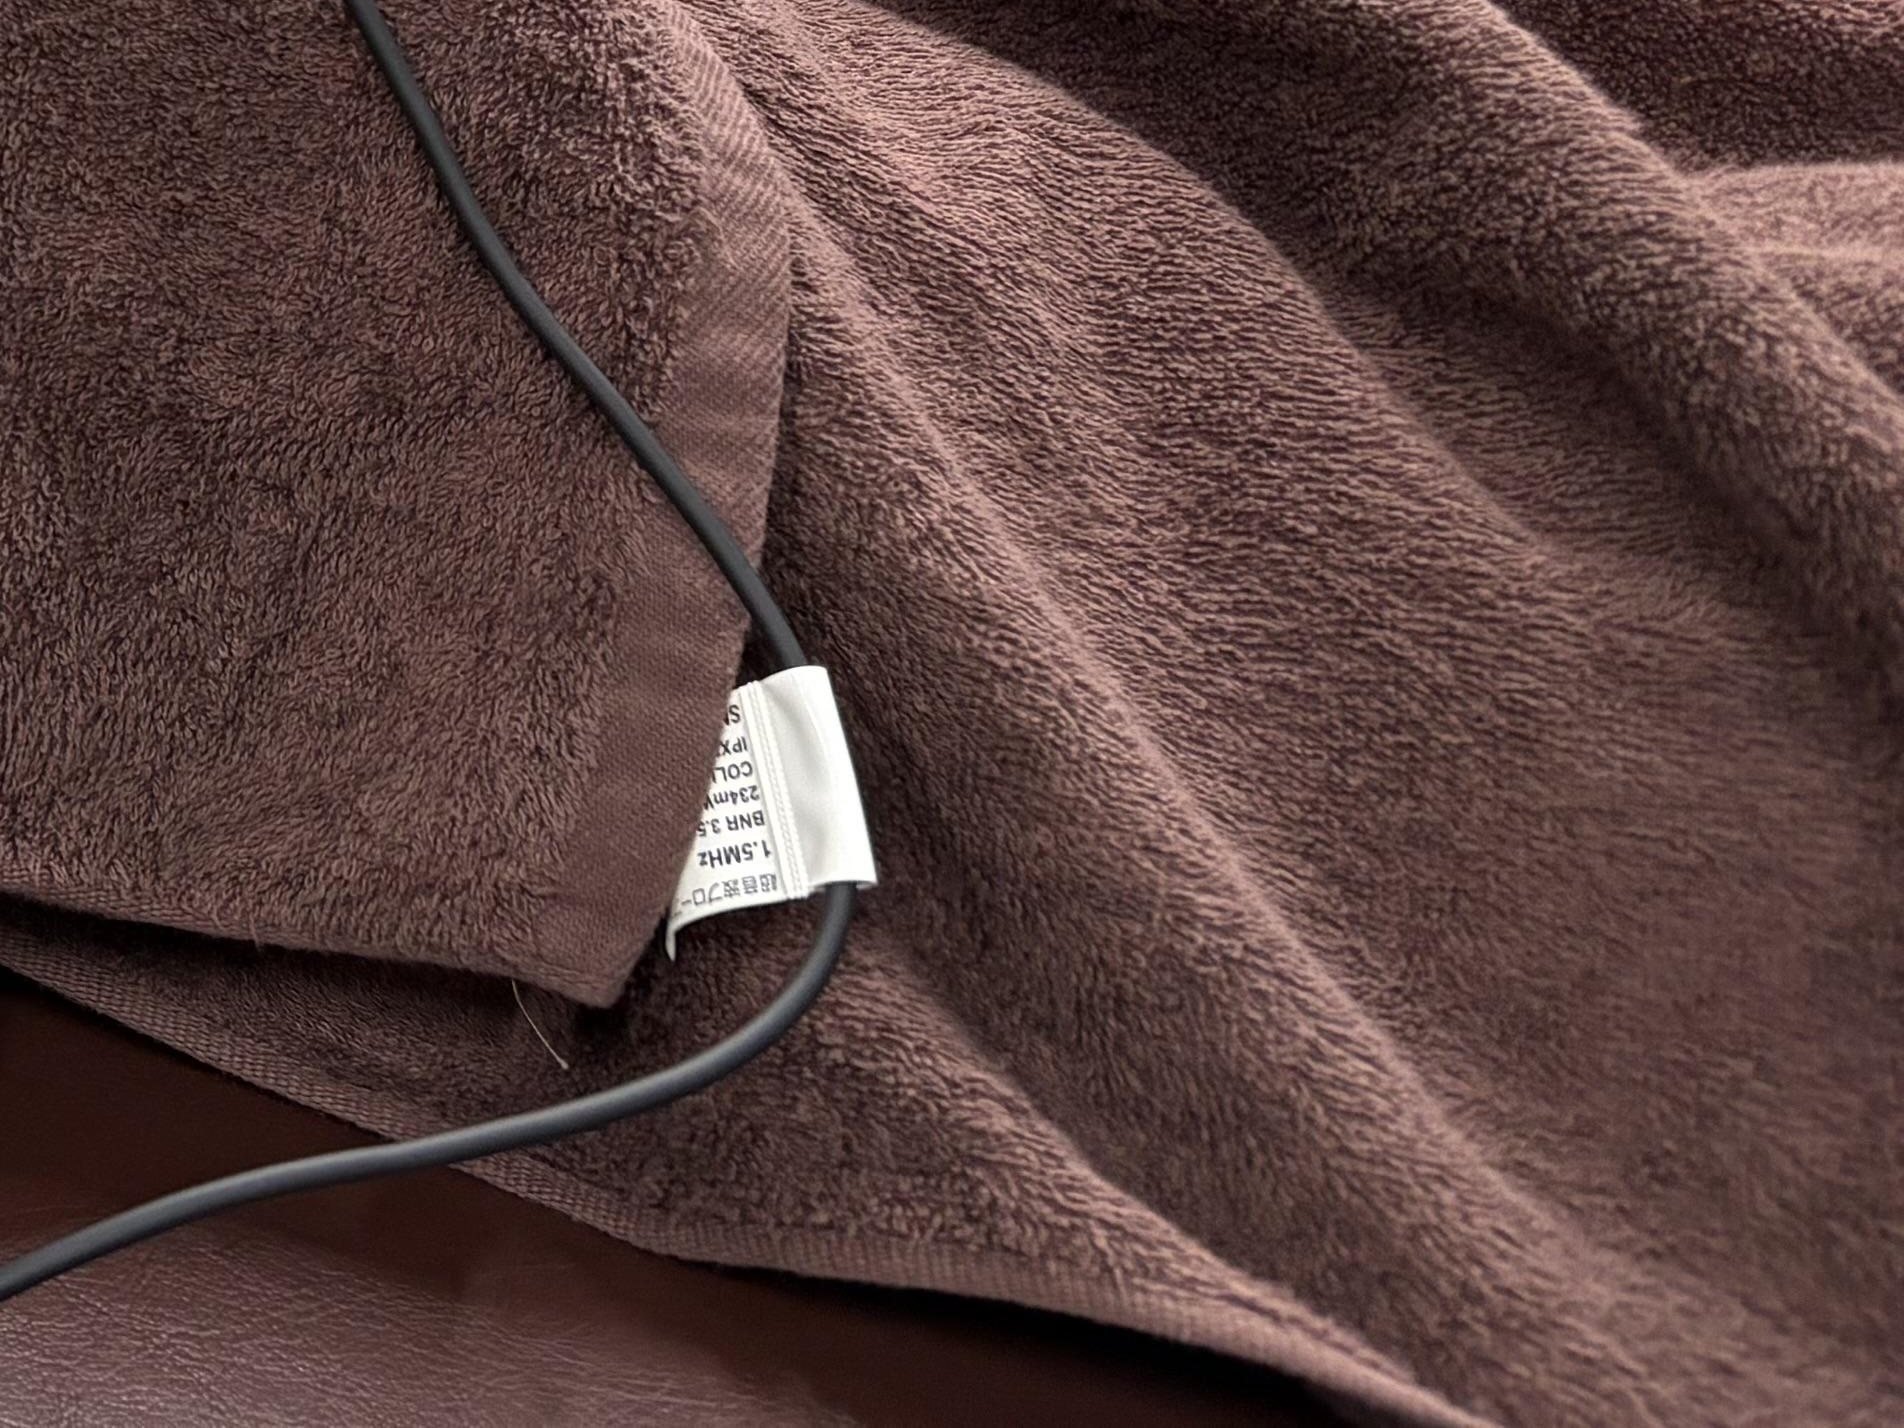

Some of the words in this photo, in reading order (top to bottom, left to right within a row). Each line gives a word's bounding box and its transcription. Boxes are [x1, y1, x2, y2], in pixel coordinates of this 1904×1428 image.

[716, 736, 748, 757] IPX
[696, 817, 721, 838] 3.5
[726, 809, 765, 832] BNR
[697, 839, 772, 869] 1.5MHz
[674, 873, 778, 916] 超音波プロー
